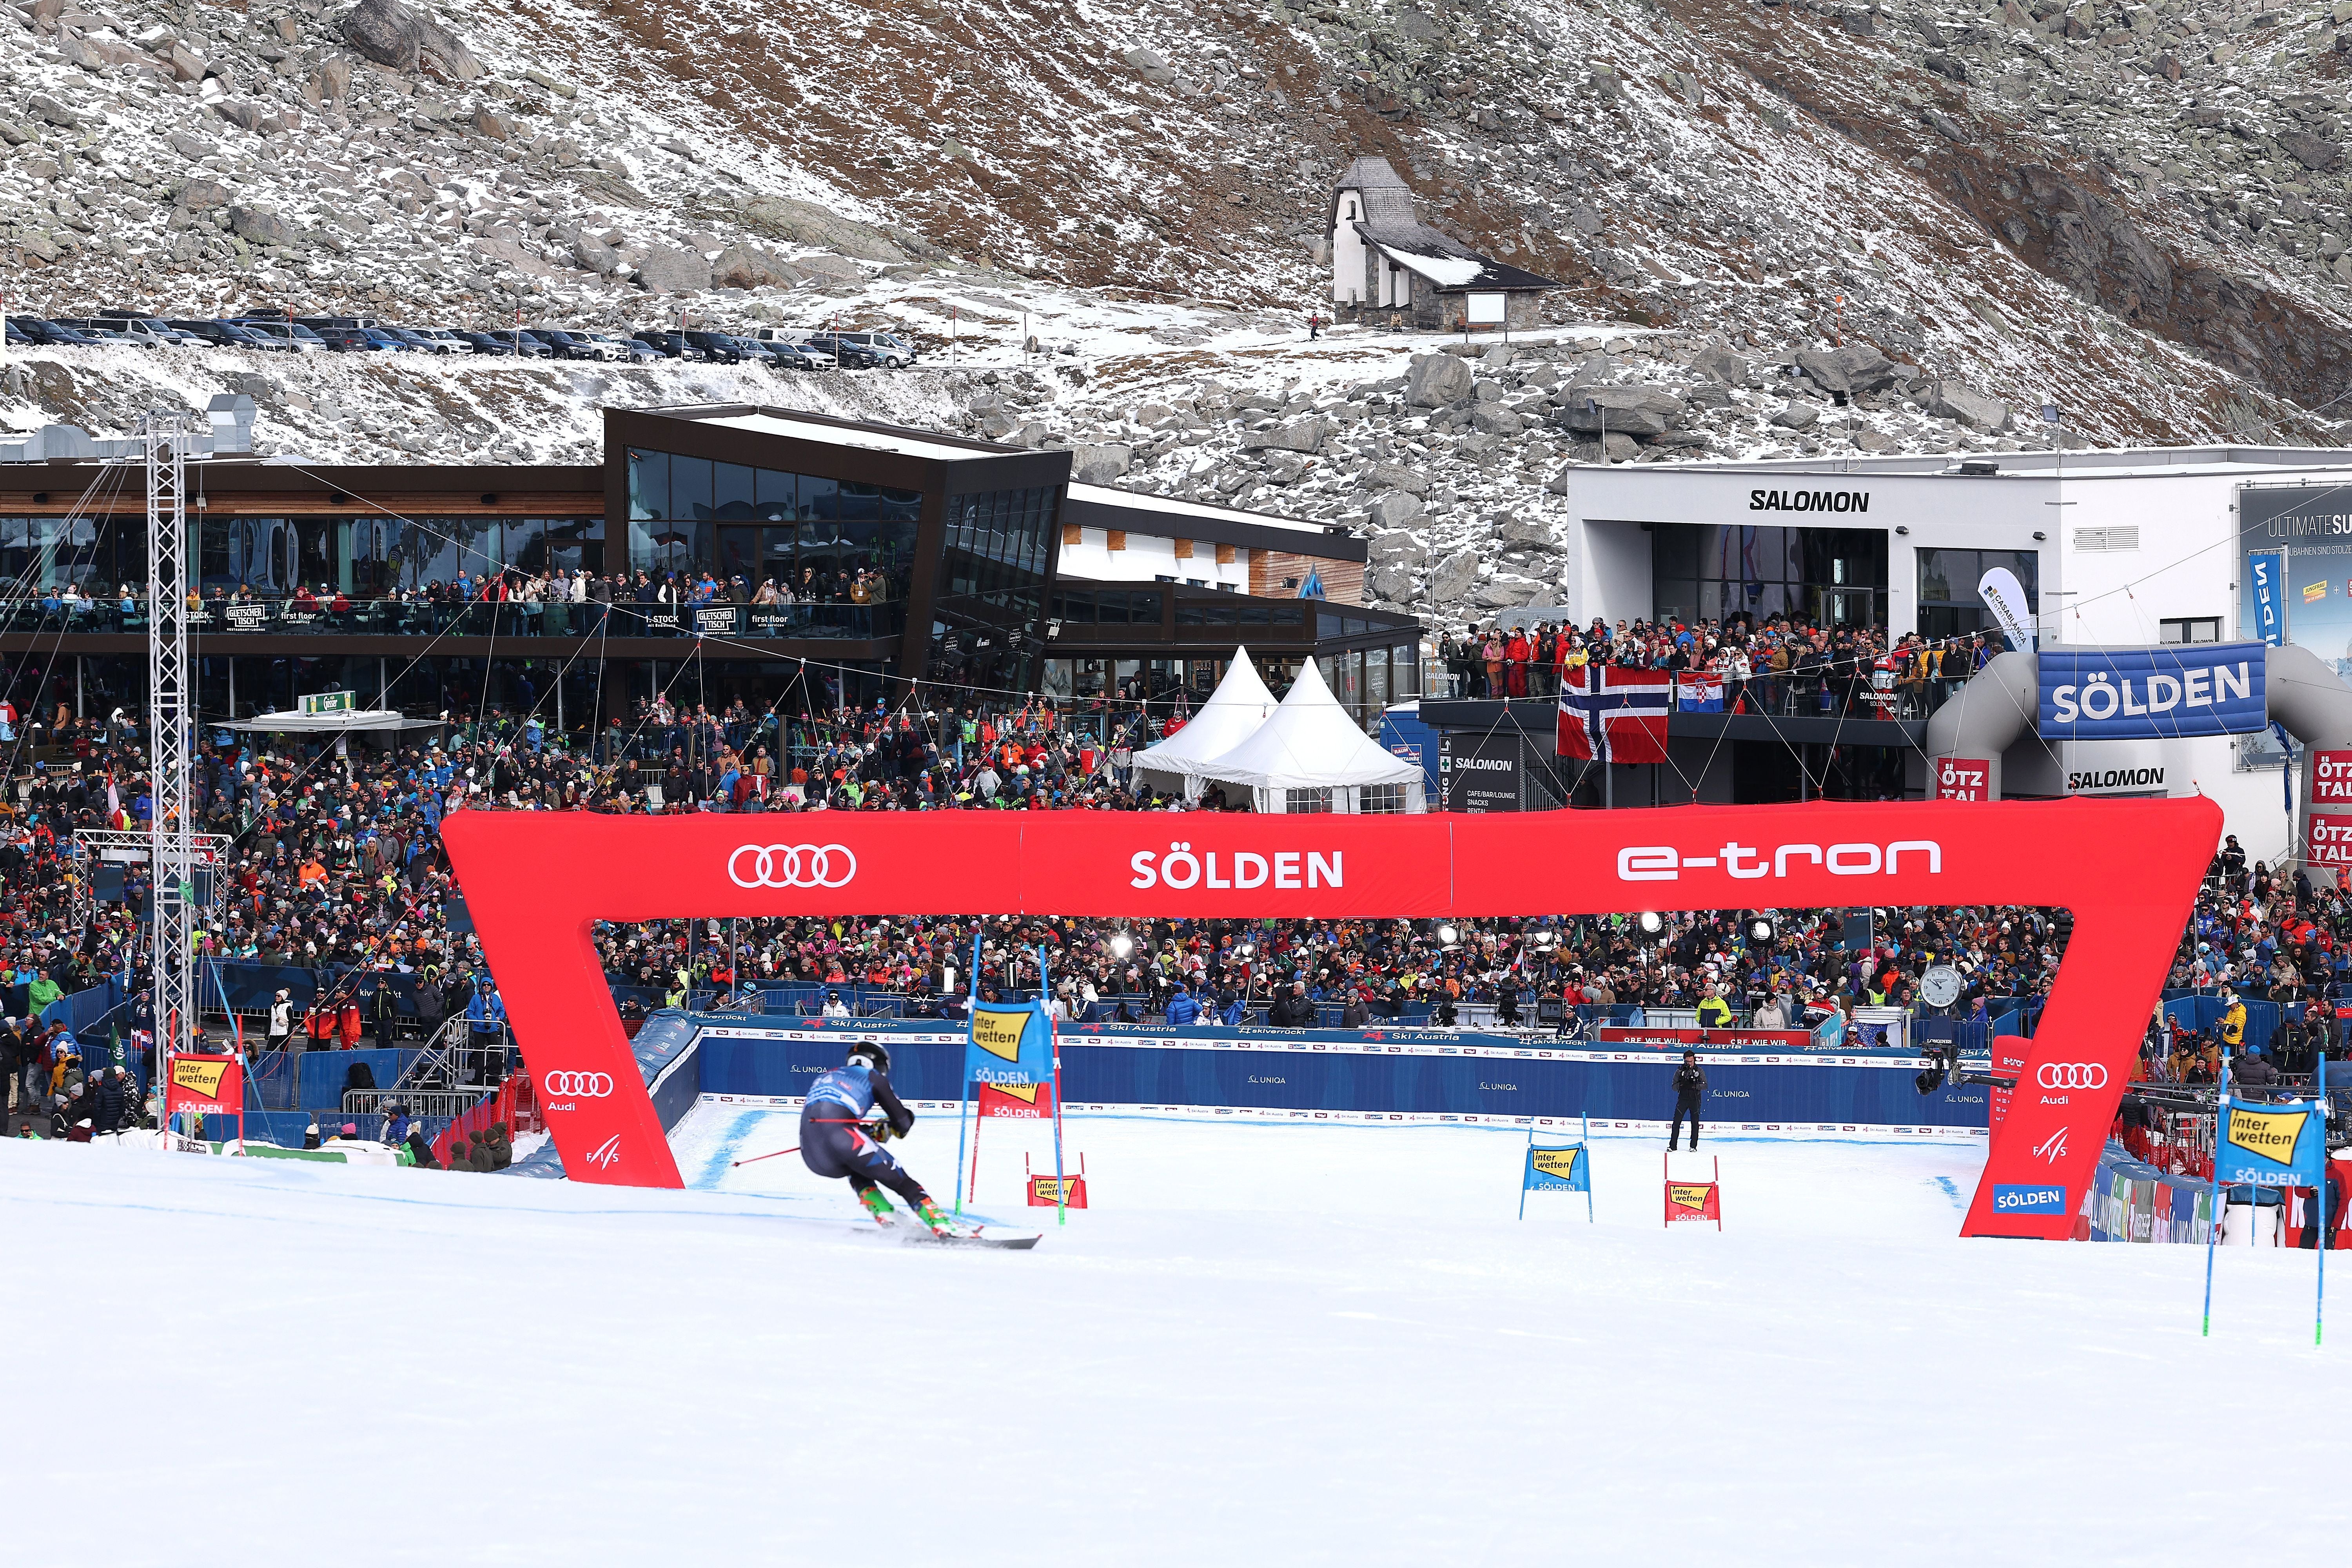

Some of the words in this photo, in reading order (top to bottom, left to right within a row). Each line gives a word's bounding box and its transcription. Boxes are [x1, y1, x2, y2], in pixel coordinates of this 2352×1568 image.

[1749, 490, 1870, 512] SALOMON
[2318, 546, 2330, 555] SIND
[2305, 582, 2325, 593] JUNGFRAU
[229, 608, 262, 618] GLETSCHER
[699, 611, 732, 620] GLETSCHER
[1995, 595, 2027, 644] CASABLANCA
[1425, 672, 1461, 681] SALOMON
[1860, 692, 1897, 701] SALOMON
[2053, 661, 2250, 723] SÖLDEN
[323, 696, 338, 711] Gösser
[1455, 758, 1512, 771] SALOMON
[1942, 764, 1984, 786] ÖTZ
[2068, 768, 2164, 789] SALOMON
[1467, 791, 1516, 799] CAFE/BAR/LOUNGE
[2313, 845, 2352, 861] TAL
[1130, 842, 1343, 889] SÖLDEN
[1617, 840, 1941, 881] e-tron
[975, 1031, 1015, 1043] wetten
[1238, 1027, 1306, 1036] #skiverrückt
[176, 1061, 202, 1073] inter
[179, 1074, 216, 1084] wetten
[975, 1067, 1029, 1083] SÖLDEN
[2040, 1096, 2068, 1104] Audi
[178, 1101, 223, 1114] SÖLDEN
[548, 1102, 575, 1111] Audi
[994, 1106, 1040, 1118] SÖLDEN
[2232, 1109, 2269, 1131] inter
[2236, 1131, 2292, 1145] wetten
[1535, 1151, 1556, 1161] inter
[1537, 1161, 1569, 1169] wetten
[2235, 1168, 2301, 1186] SÖLDEN
[1038, 1180, 1057, 1189] inter
[1539, 1181, 1575, 1191] SÖLDEN
[1672, 1187, 1692, 1195] inter
[1998, 1191, 2060, 1209] SÖLDEN
